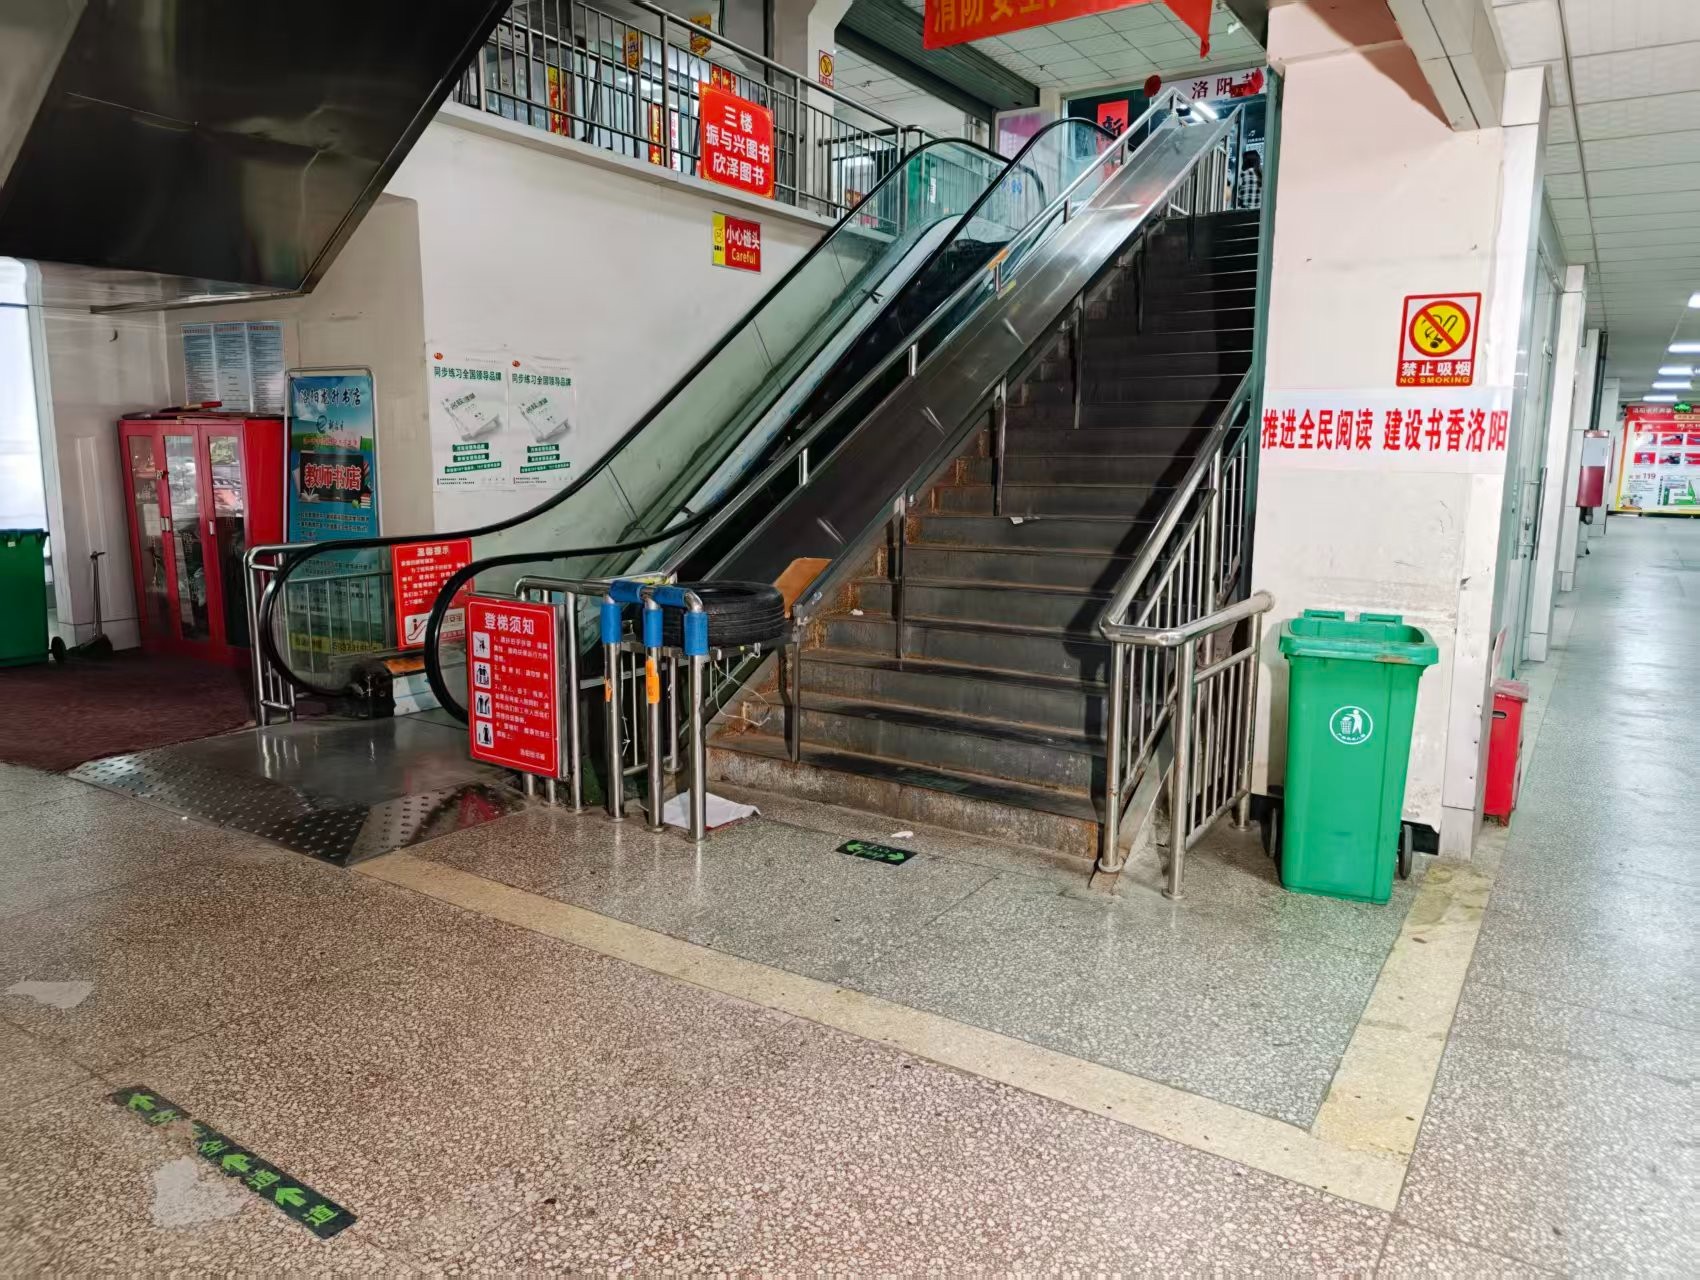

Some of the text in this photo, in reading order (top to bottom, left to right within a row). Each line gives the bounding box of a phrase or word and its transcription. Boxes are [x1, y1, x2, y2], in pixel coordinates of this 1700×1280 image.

[723, 105, 753, 134] 三楼
[705, 124, 770, 164] 振与兴图书
[713, 151, 764, 186] 欣泽图书
[726, 224, 760, 250] 小心碰头
[731, 247, 756, 264] Careful
[434, 366, 502, 381] 同步练习全国领导品牌
[511, 373, 571, 387] 同步练习全国领导品牌
[1402, 361, 1471, 377] 禁止吸烟
[1420, 376, 1470, 384] SMOKING
[1262, 407, 1509, 453] 推进全民阅读 建设书香洛阳
[304, 463, 361, 490] 教师书店
[484, 612, 535, 635] 登梯须知
